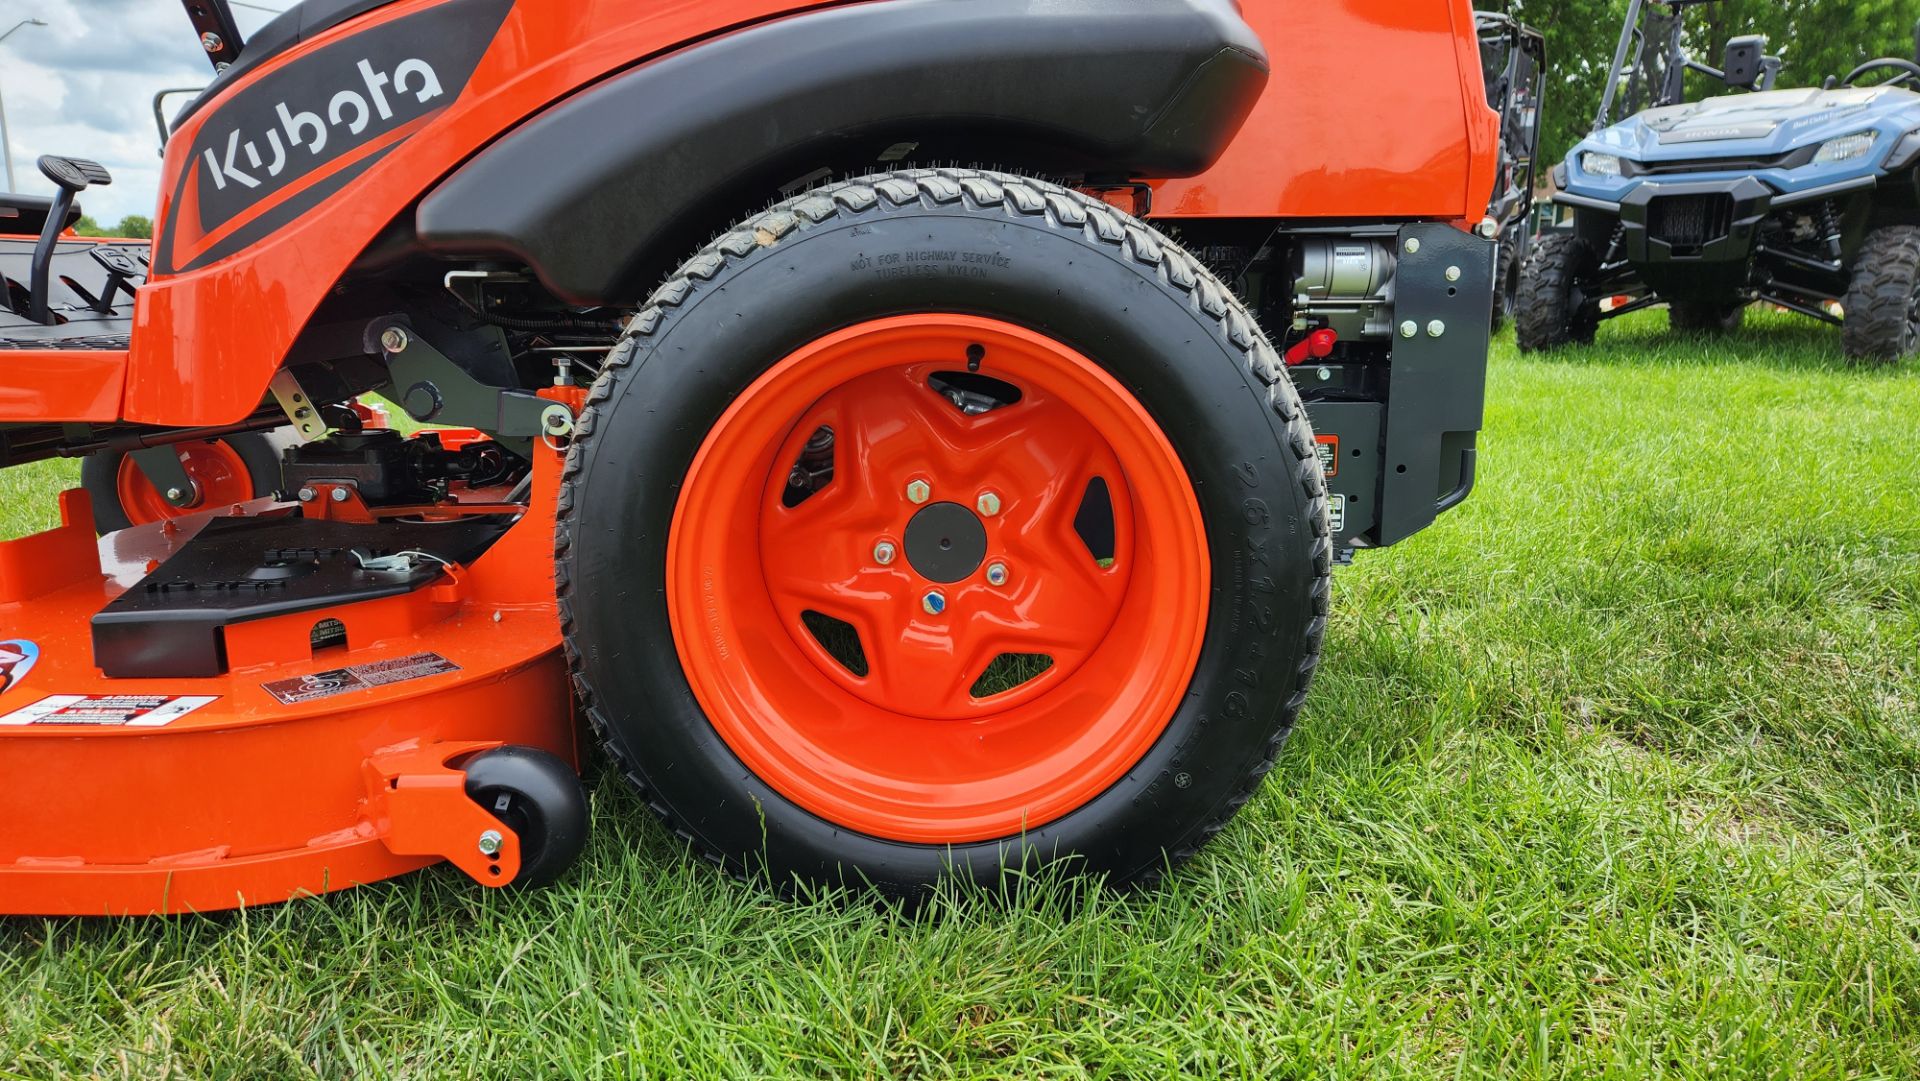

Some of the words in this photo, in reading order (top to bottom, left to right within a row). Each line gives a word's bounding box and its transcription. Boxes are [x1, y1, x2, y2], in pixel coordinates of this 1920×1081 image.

[203, 57, 444, 191] Kubota
[1685, 127, 1741, 138] HONDA
[850, 257, 872, 271] NOT
[878, 253, 899, 265] FOR
[905, 249, 957, 262] HIGHWAY
[961, 252, 1012, 269] SERVICE
[874, 264, 939, 280] TUBELESS
[946, 265, 989, 280] NYLON
